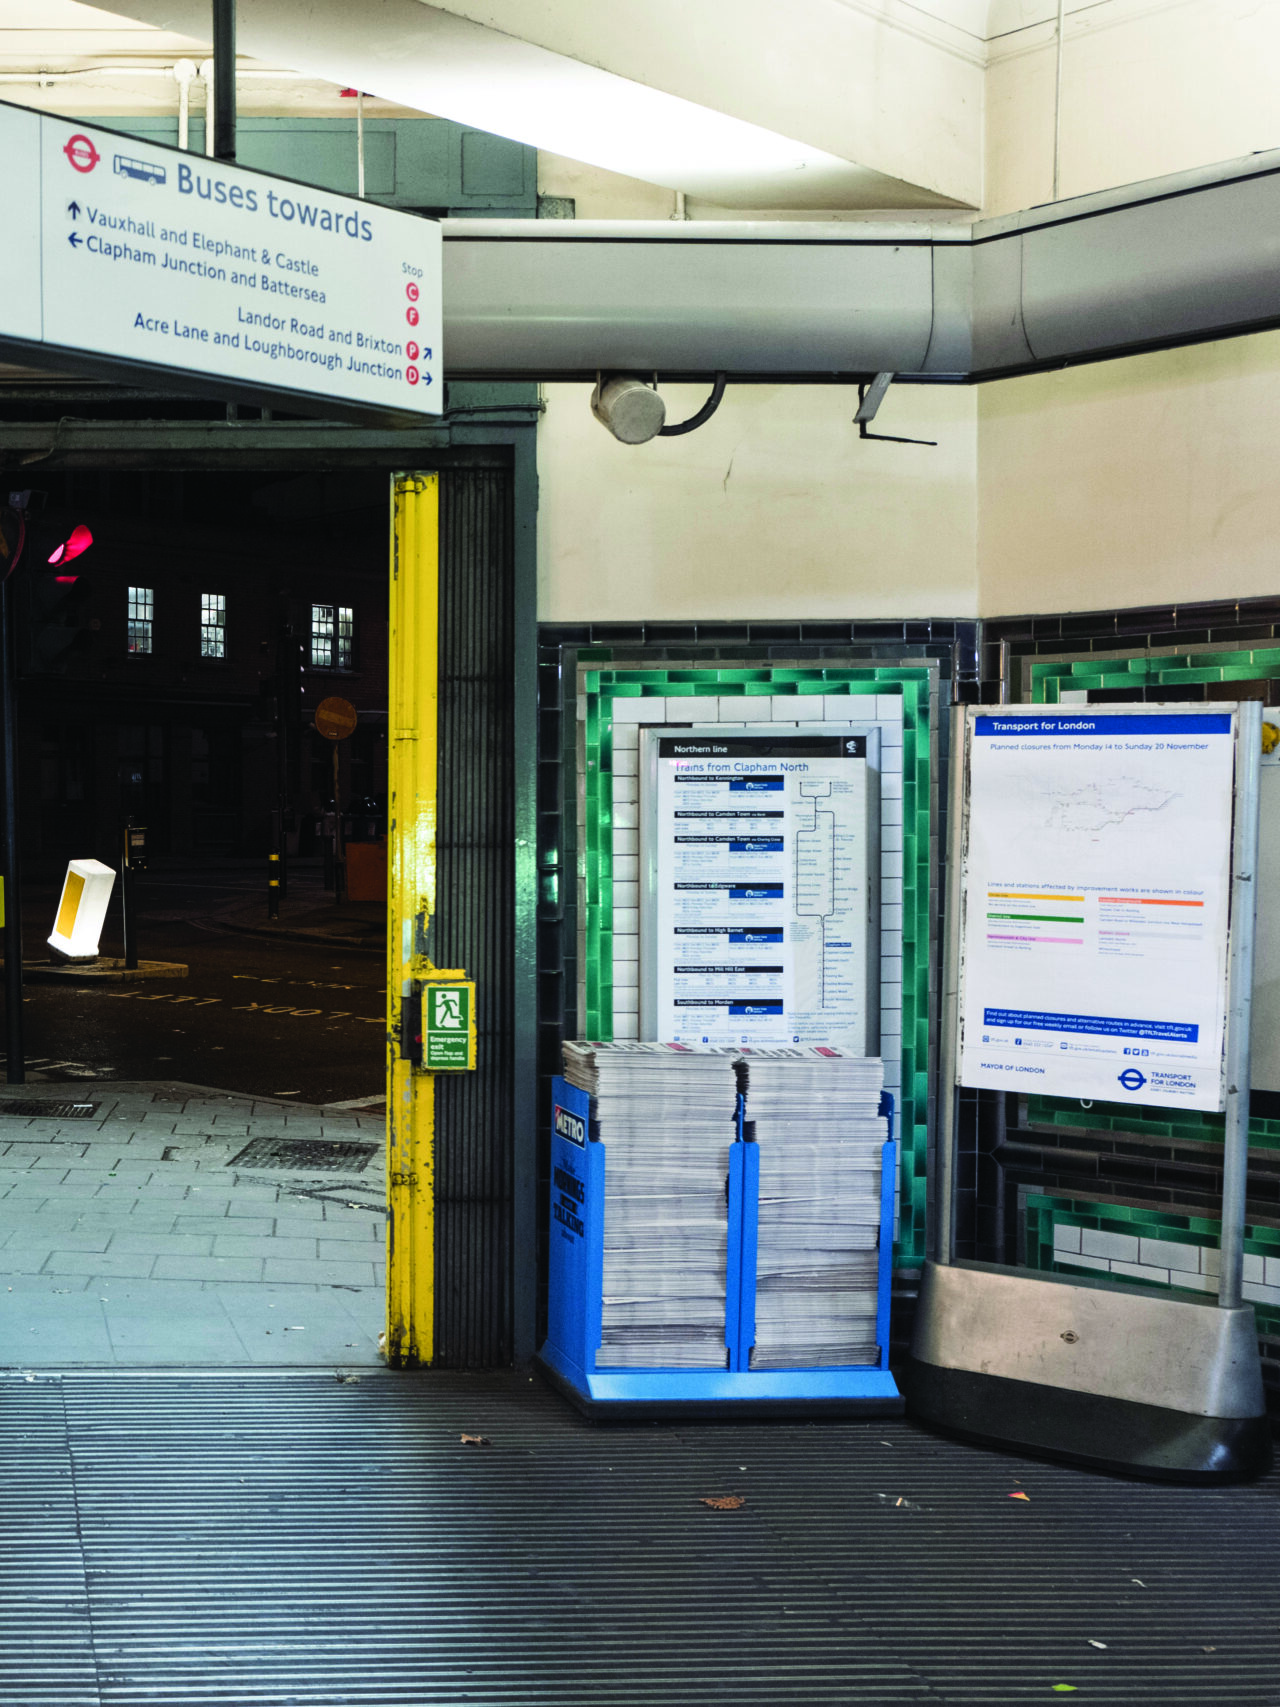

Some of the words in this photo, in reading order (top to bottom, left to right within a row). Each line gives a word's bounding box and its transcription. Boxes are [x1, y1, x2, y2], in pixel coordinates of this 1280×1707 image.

[177, 163, 258, 212] Buses
[267, 190, 374, 242] towards
[86, 206, 155, 239] Vauxhall
[160, 224, 188, 246] and
[192, 232, 257, 264] Elephant
[261, 249, 272, 265] &
[275, 253, 320, 278] Castle
[86, 234, 156, 267] Clapham
[161, 252, 226, 282] Junction
[230, 268, 257, 289] and
[261, 274, 326, 304] Battersea
[401, 261, 423, 278] Stop
[237, 306, 286, 332] Landor
[290, 318, 324, 339] Road
[328, 327, 352, 346] and
[356, 331, 402, 356] Brixton
[134, 312, 169, 334] Acre
[174, 320, 209, 343] Lane
[213, 327, 240, 348] and
[244, 332, 342, 370] Loughborough
[347, 356, 403, 381] Junction
[993, 721, 1038, 732] Transport
[1041, 721, 1056, 730] for
[1058, 721, 1095, 730] London
[674, 744, 711, 754] Northern
[713, 744, 728, 754] line
[990, 743, 1019, 751] Planned
[1021, 743, 1051, 751] closures
[1073, 743, 1103, 752] Monday
[1125, 743, 1153, 751] Sunday
[1167, 742, 1209, 750] November
[675, 762, 705, 772] Trains
[707, 762, 731, 772] from
[733, 762, 777, 774] Clapham
[780, 762, 809, 772] North
[715, 775, 744, 783] Kennington
[107, 989, 223, 1007] LEFT
[232, 1001, 352, 1020] LOOK
[1023, 1013, 1044, 1021] planned
[1077, 1016, 1105, 1025] alternative
[996, 1017, 1007, 1025] sign
[1007, 1018, 1014, 1026] up
[1044, 1021, 1062, 1029] weekly
[1119, 1027, 1138, 1035] Twitter
[980, 1062, 1004, 1071] MAYOR
[1015, 1065, 1046, 1075] LONDON
[1151, 1071, 1192, 1081] TRANSPORT
[1150, 1078, 1164, 1086] FOR
[1165, 1080, 1196, 1089] LONDON
[556, 1112, 584, 1143] METRO
